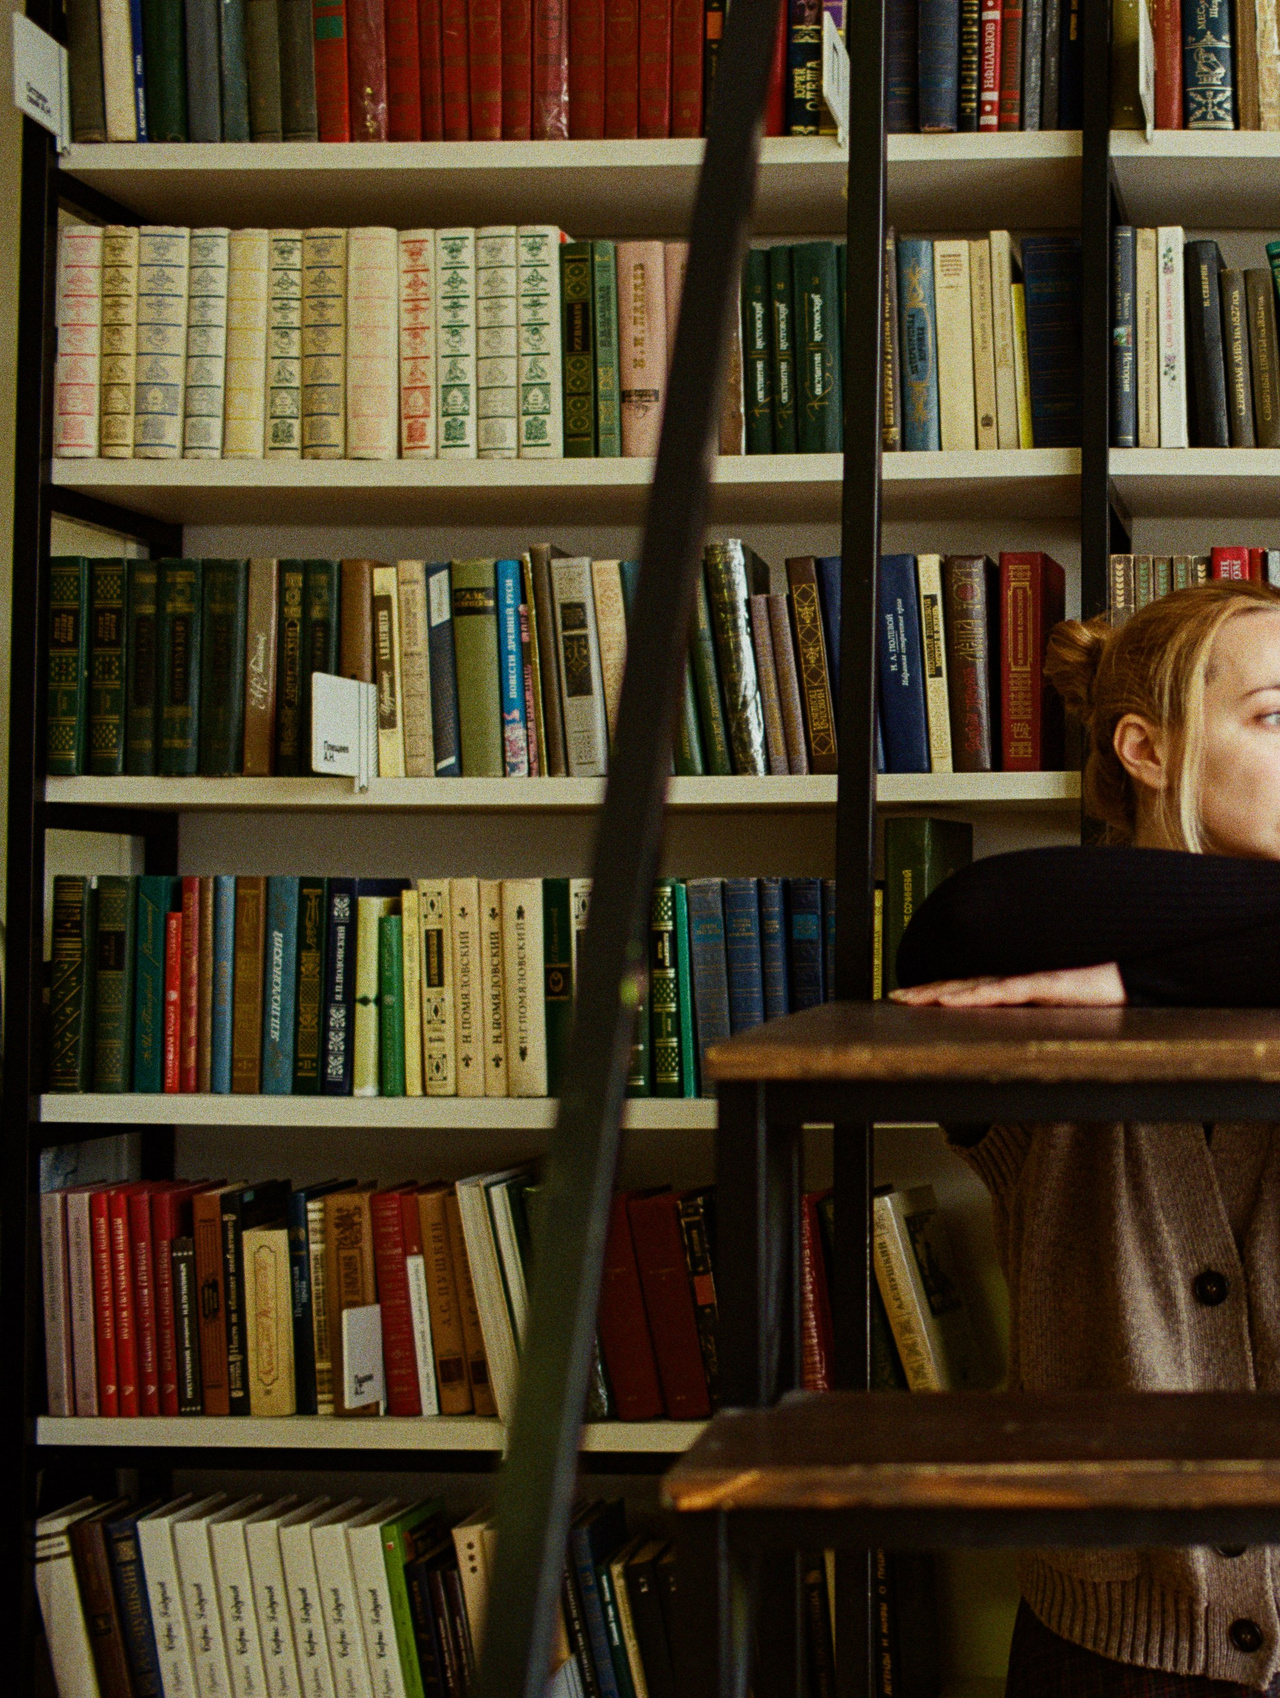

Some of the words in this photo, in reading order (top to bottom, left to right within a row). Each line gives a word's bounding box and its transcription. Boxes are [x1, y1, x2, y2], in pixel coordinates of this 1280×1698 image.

[793, 67, 806, 99] ЮРИЙ
[1231, 305, 1242, 326] 1827
[1121, 352, 1132, 393] История
[1234, 366, 1247, 416] СЕВЕРНАЯ
[504, 579, 514, 605] РУСИ
[504, 607, 516, 652] ДРЕВНЕЙ
[885, 613, 896, 652] ПОЛЕВОЙ
[507, 655, 517, 698] ПОВЕСТИ
[902, 869, 912, 915] СОЧИНЕНИЙ
[459, 930, 472, 1030] ПОМЯЛОВСКИЙ
[490, 930, 502, 1030] ПОМЯЛОВСКИЙ
[431, 1221, 449, 1298] ПУШКИН
[878, 1585, 887, 1595] О
[880, 1601, 889, 1634] МИФЫ
[881, 1638, 889, 1647] И
[881, 1652, 893, 1696] ЛЕГЕНДЫ
